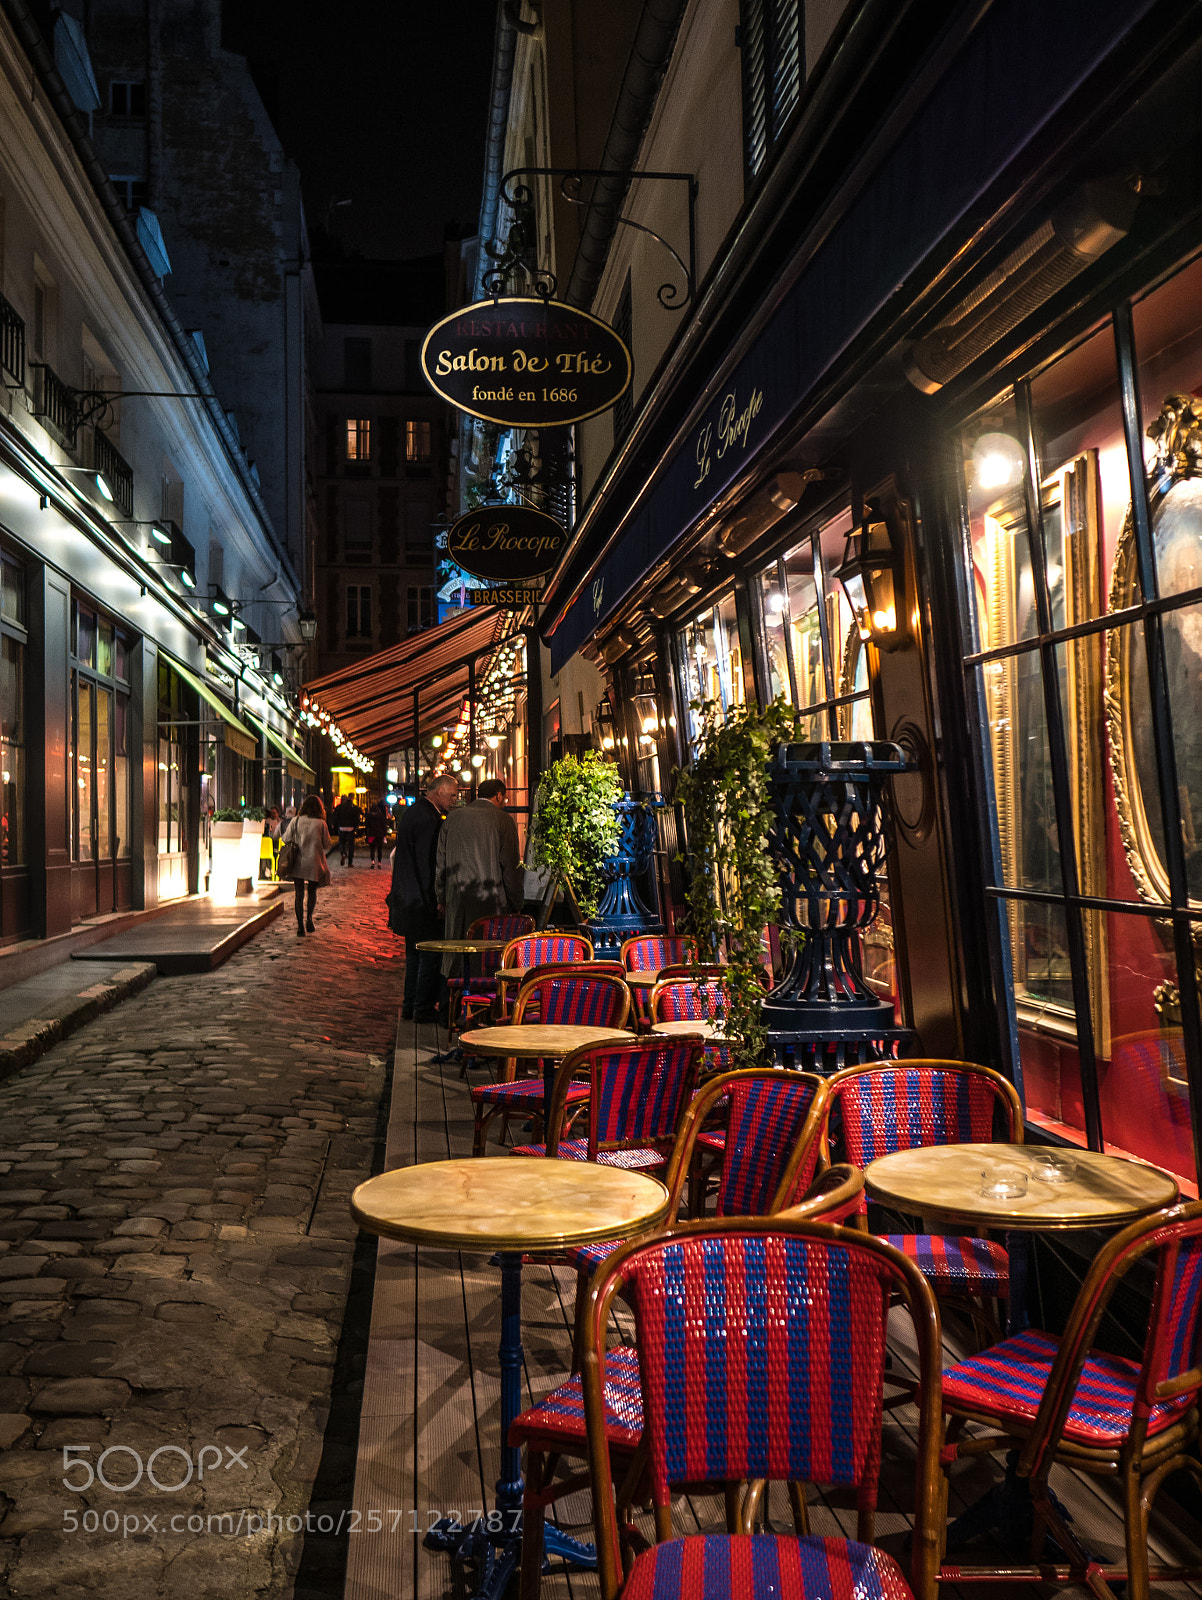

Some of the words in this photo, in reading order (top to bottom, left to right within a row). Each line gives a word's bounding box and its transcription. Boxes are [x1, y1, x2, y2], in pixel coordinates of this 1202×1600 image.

[456, 320, 593, 339] RESTAURANT
[435, 348, 507, 376] Salon
[512, 349, 550, 372] de
[556, 351, 612, 374] Thé
[472, 385, 514, 401] fondé
[518, 391, 536, 402] en
[541, 387, 578, 402] 1686
[694, 422, 712, 489] Le
[451, 523, 481, 551] Le
[481, 522, 561, 558] Procope
[473, 589, 542, 604] BRASSERIE
